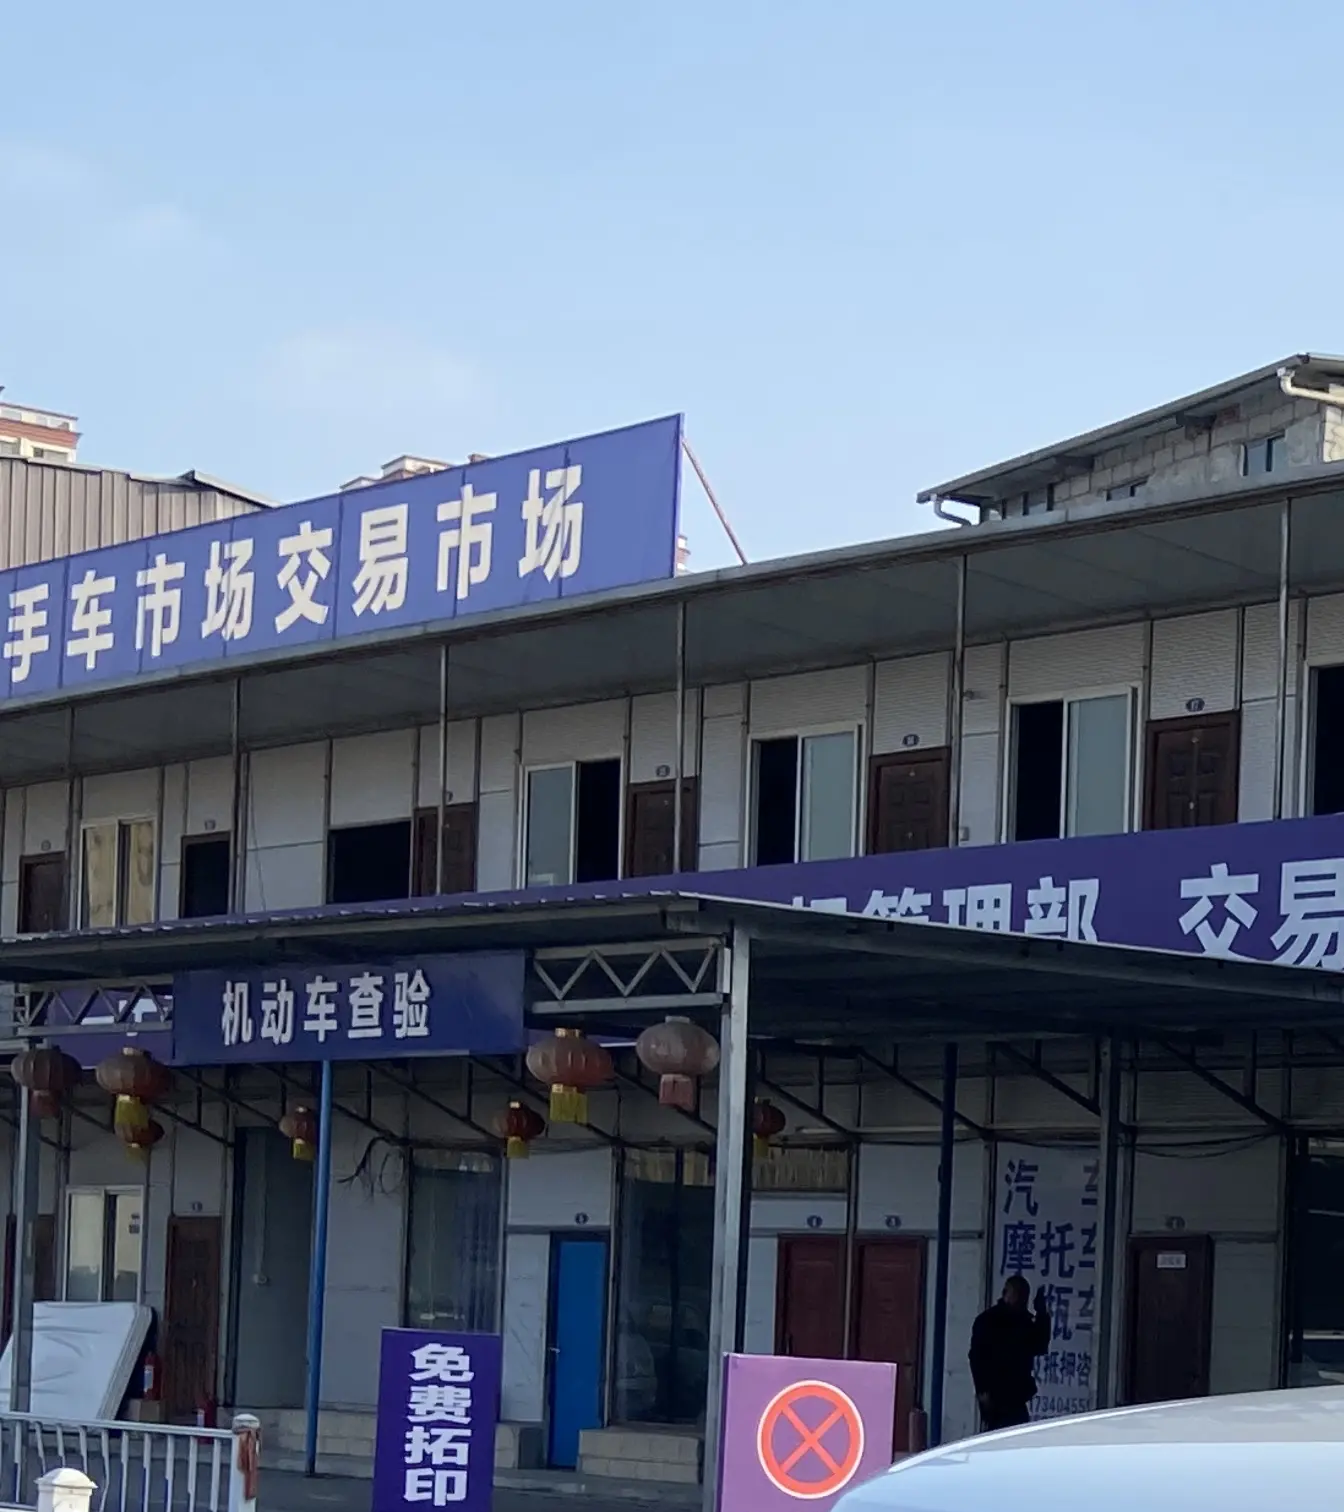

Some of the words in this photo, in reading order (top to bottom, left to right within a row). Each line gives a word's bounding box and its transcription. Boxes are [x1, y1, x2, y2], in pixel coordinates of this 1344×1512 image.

[3, 464, 584, 683] 手车市场交易市场
[221, 969, 431, 1046] 机动车查验
[403, 1343, 475, 1507] 免费拓印
